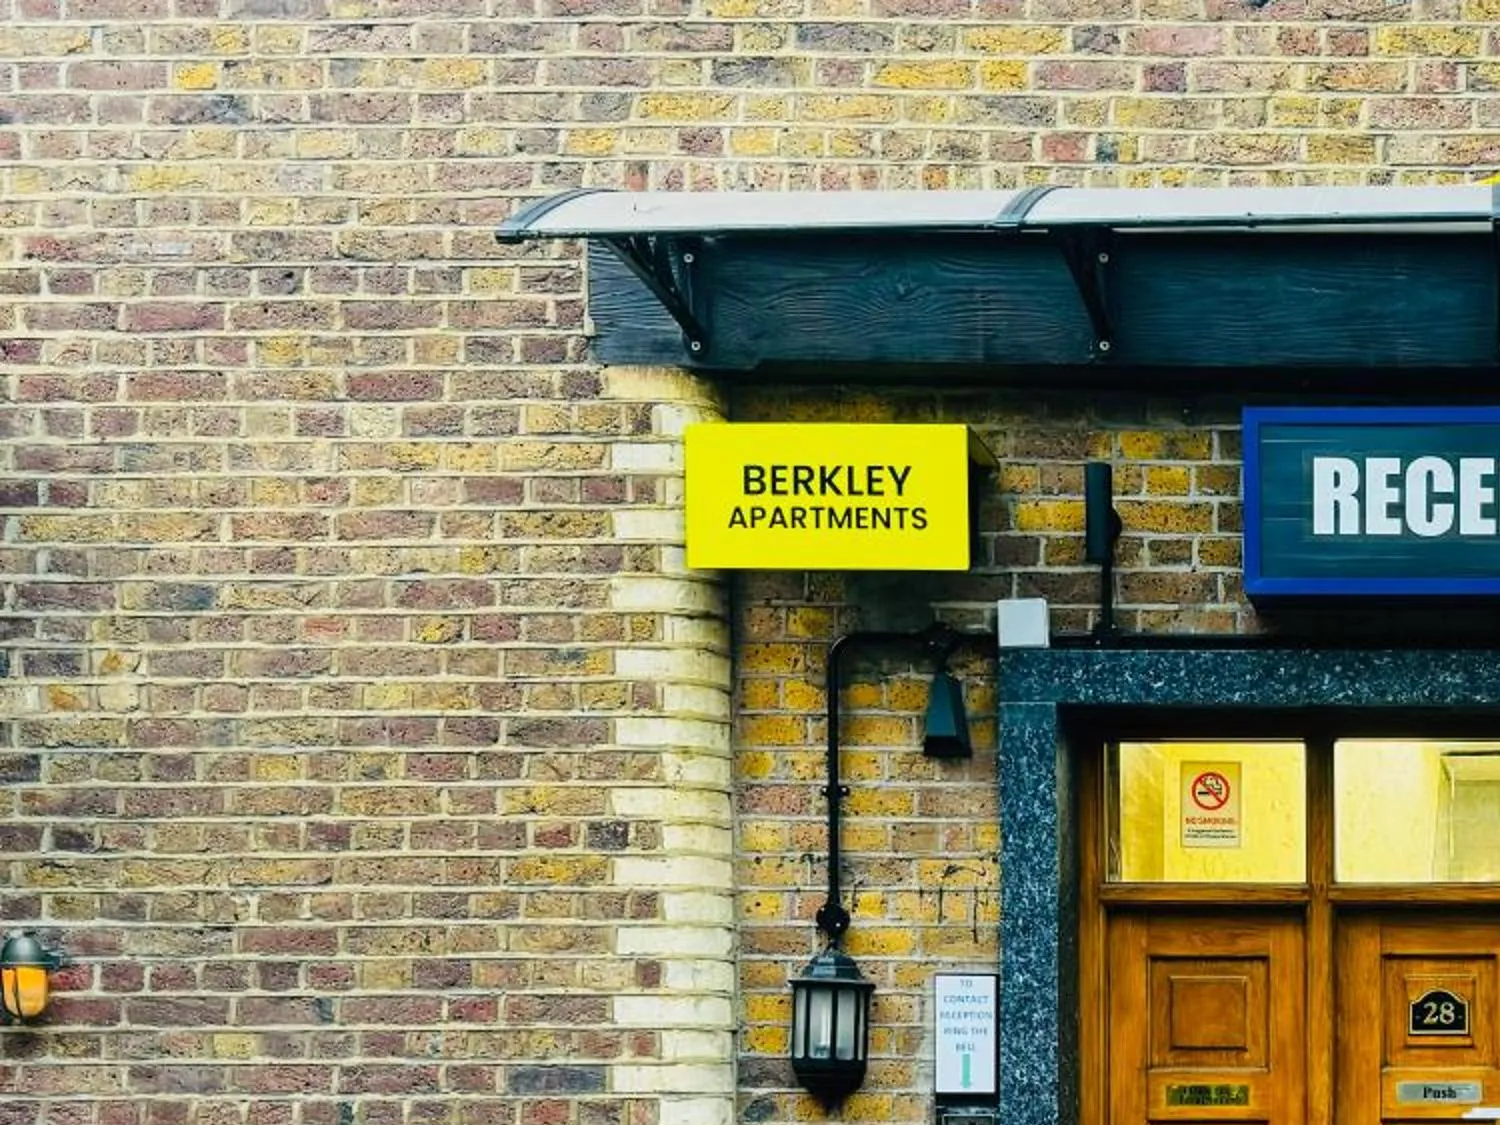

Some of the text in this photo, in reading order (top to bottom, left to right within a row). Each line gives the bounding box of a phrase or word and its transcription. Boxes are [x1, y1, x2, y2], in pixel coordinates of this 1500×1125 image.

[743, 465, 912, 496] BERKLEY
[728, 506, 928, 531] APARTMENTS
[1422, 1001, 1456, 1025] 28
[1423, 1085, 1457, 1099] Push
